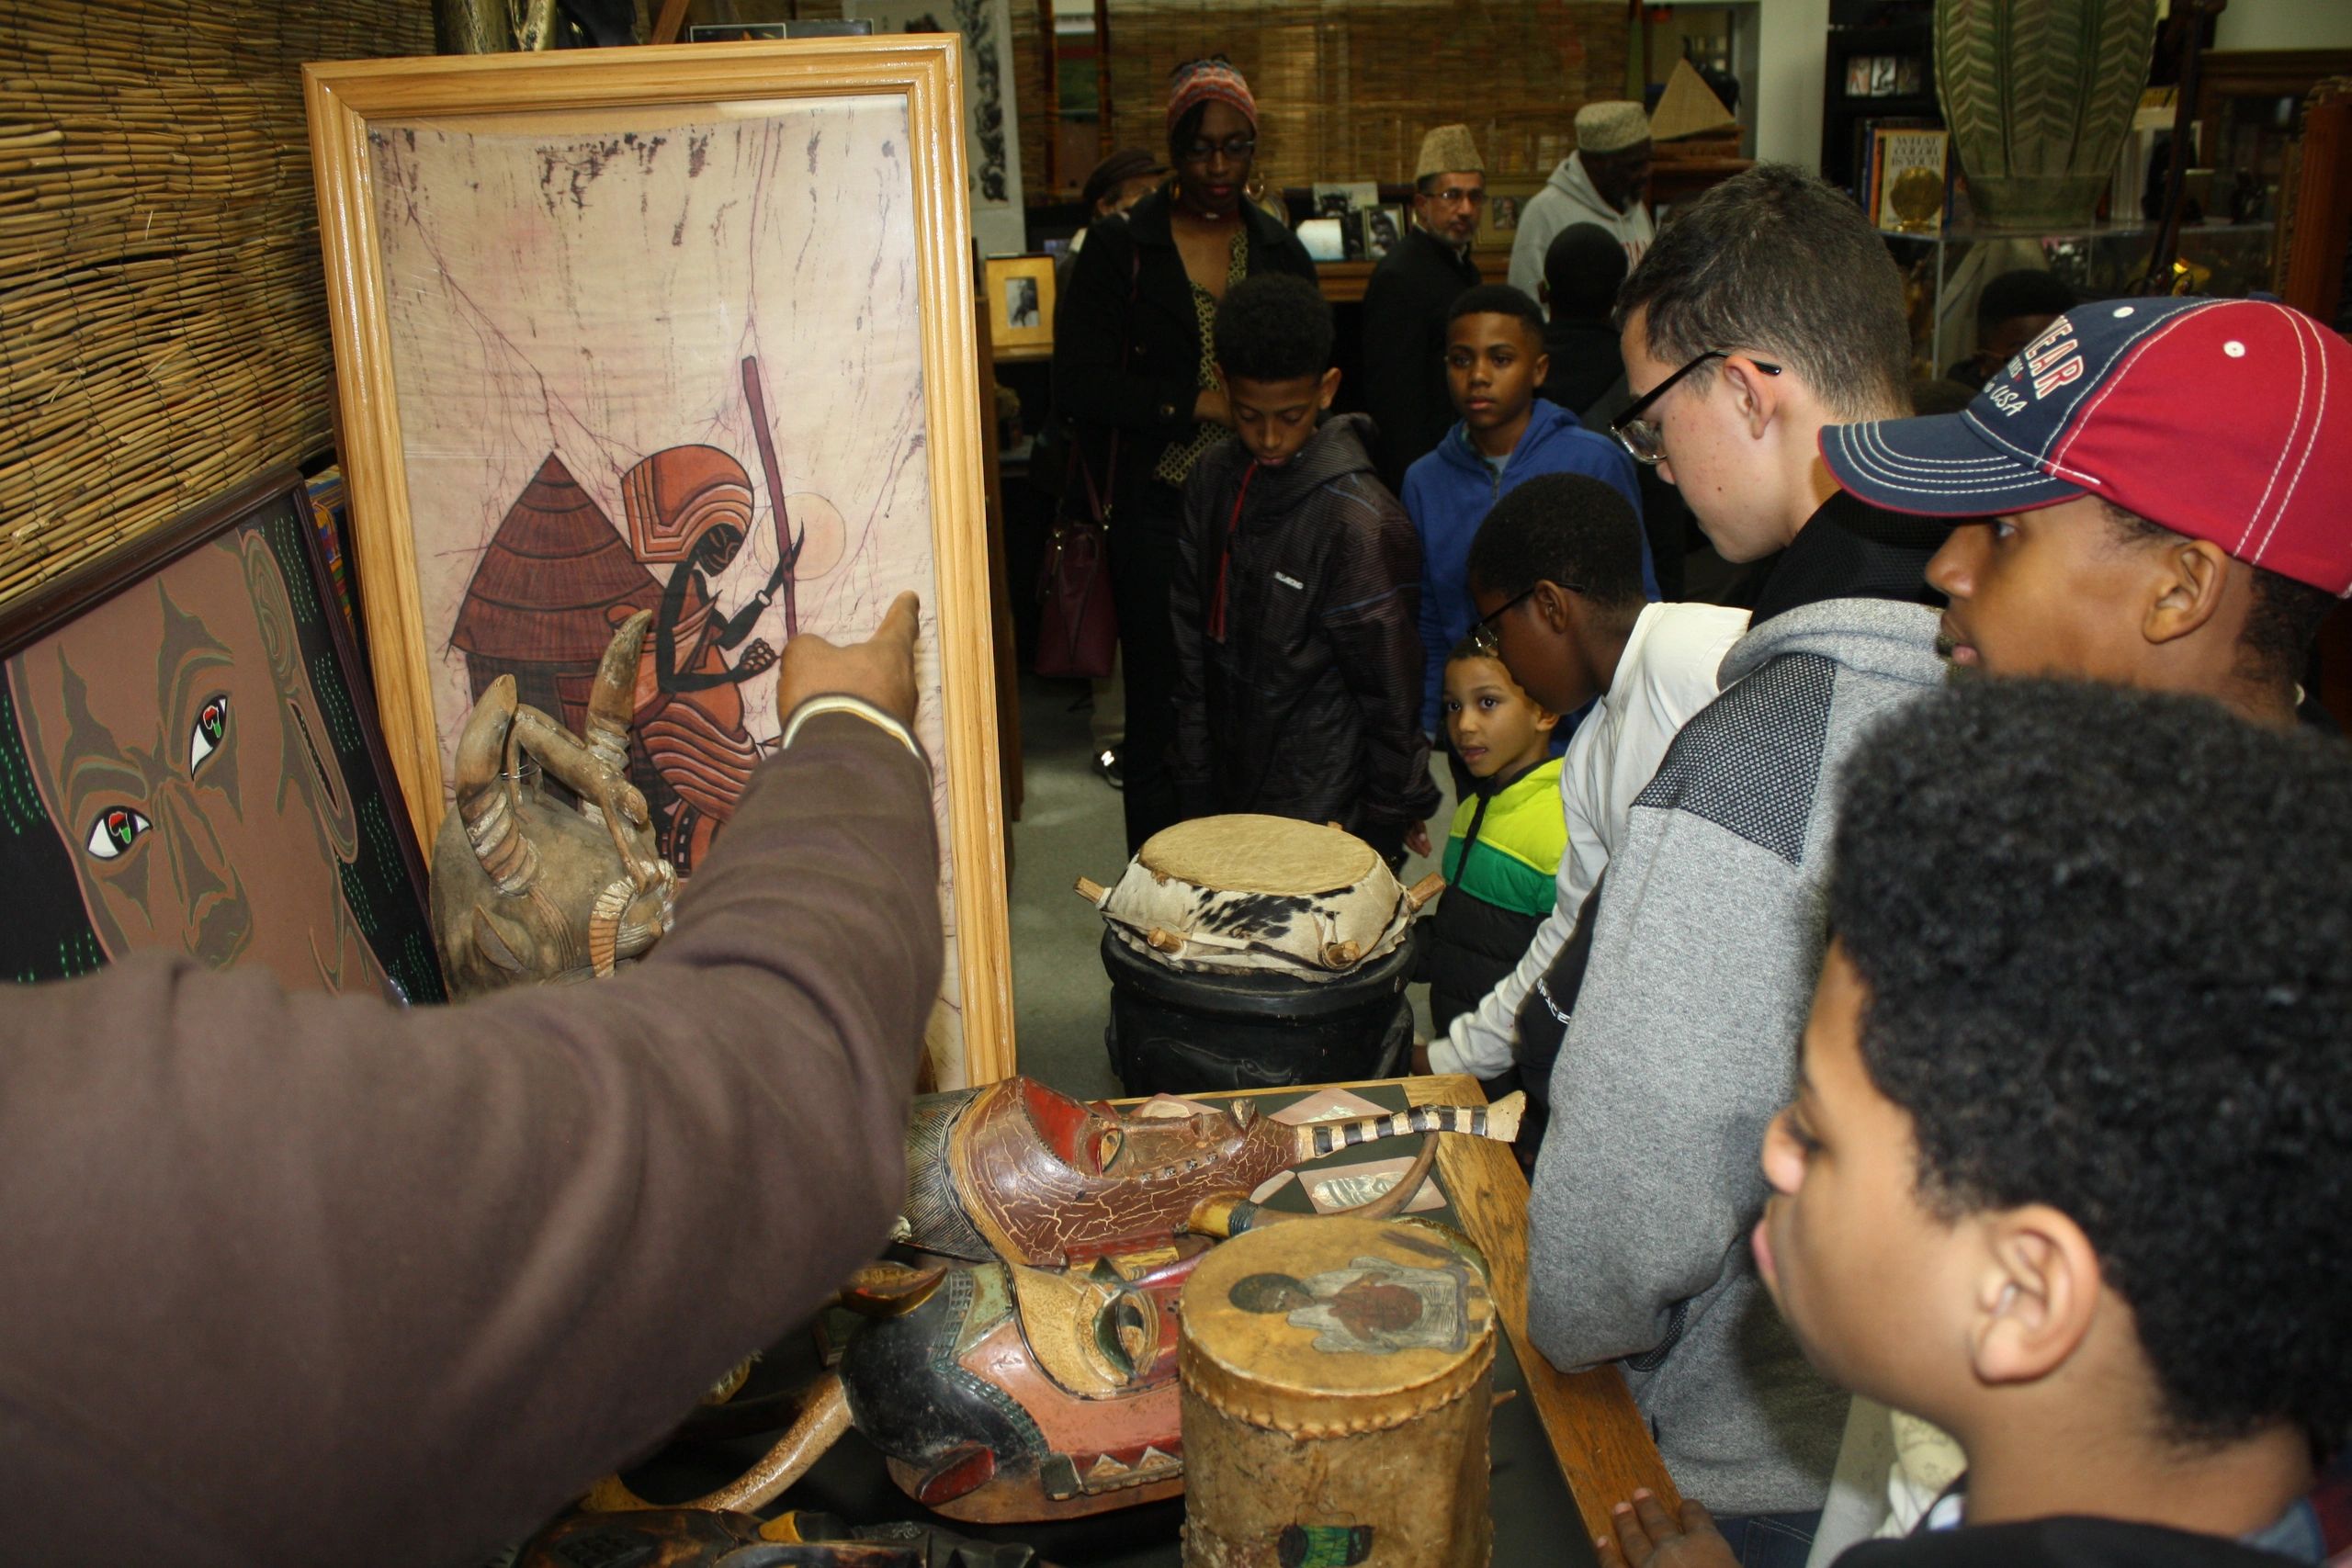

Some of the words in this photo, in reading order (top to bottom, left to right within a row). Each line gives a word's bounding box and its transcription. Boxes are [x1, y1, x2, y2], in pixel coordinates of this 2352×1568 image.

[1896, 136, 1939, 145] WHAT
[1894, 145, 1939, 154] COLOR
[1905, 156, 1939, 165] YOUR
